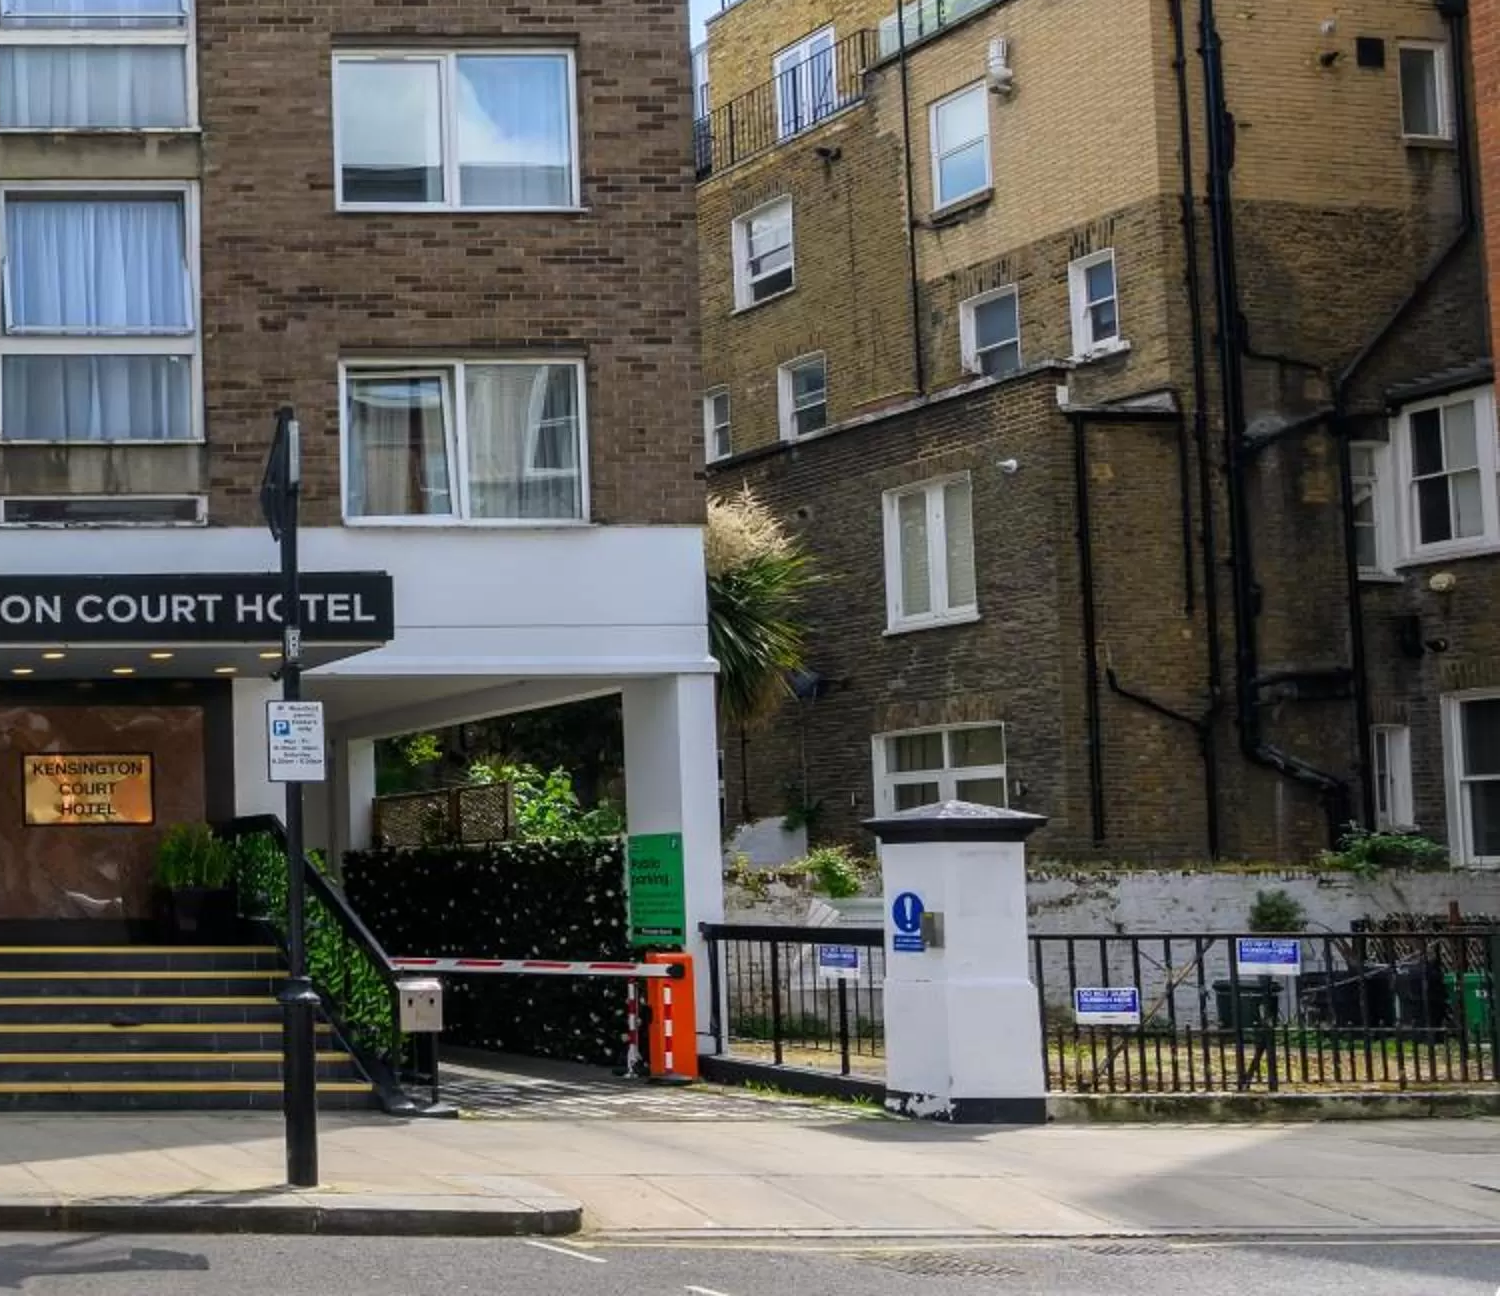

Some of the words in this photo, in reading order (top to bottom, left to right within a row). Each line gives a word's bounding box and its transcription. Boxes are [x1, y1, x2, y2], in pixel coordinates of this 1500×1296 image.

[75, 594, 223, 623] COURT
[33, 762, 143, 775] KENSINGTON
[60, 782, 116, 795] COURT
[61, 803, 116, 816] HOTEL
